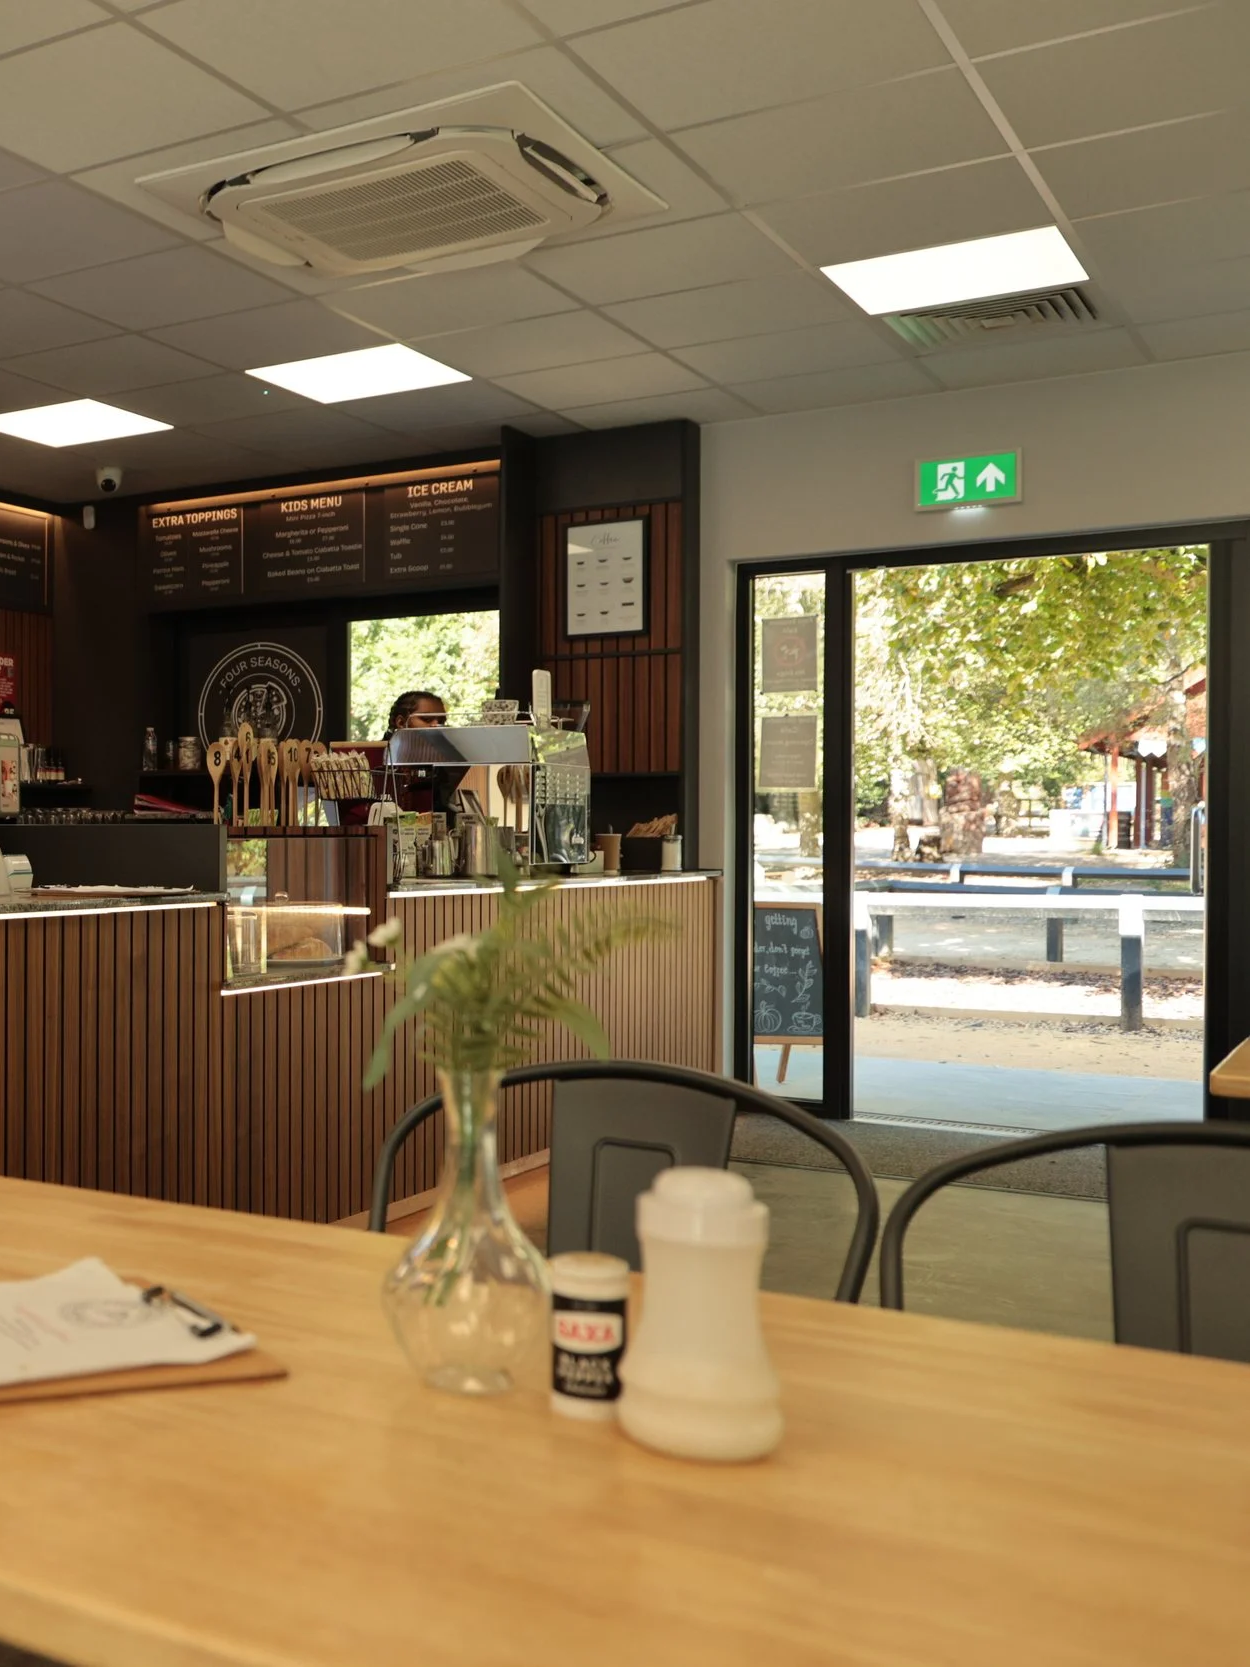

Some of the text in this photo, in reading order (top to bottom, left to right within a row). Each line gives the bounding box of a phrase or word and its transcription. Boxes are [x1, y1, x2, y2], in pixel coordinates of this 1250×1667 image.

[407, 479, 474, 498] ICE CREAM
[280, 496, 342, 514] KIDS MENU
[434, 497, 469, 506] Chocolate,
[152, 508, 238, 529] EXTRA TOPPINGS
[390, 510, 428, 520] Strawberry,
[454, 502, 493, 512] Bubblegum
[276, 529, 309, 539] Margherita
[317, 524, 349, 535] Pepperoni
[390, 523, 428, 533] Single Cone
[199, 545, 233, 553] Mushrooms
[390, 538, 411, 546] Waffle
[263, 552, 284, 560] Cheese
[314, 546, 339, 554] Ciabatta
[408, 565, 429, 573] Scoop
[220, 657, 301, 689] FOUR SEASONS
[214, 751, 221, 767] 8
[234, 748, 241, 762] 4
[246, 748, 250, 764] 1
[288, 748, 299, 762] 10
[305, 747, 311, 764] 7
[765, 913, 798, 935] getting
[559, 1320, 616, 1344] SAXA
